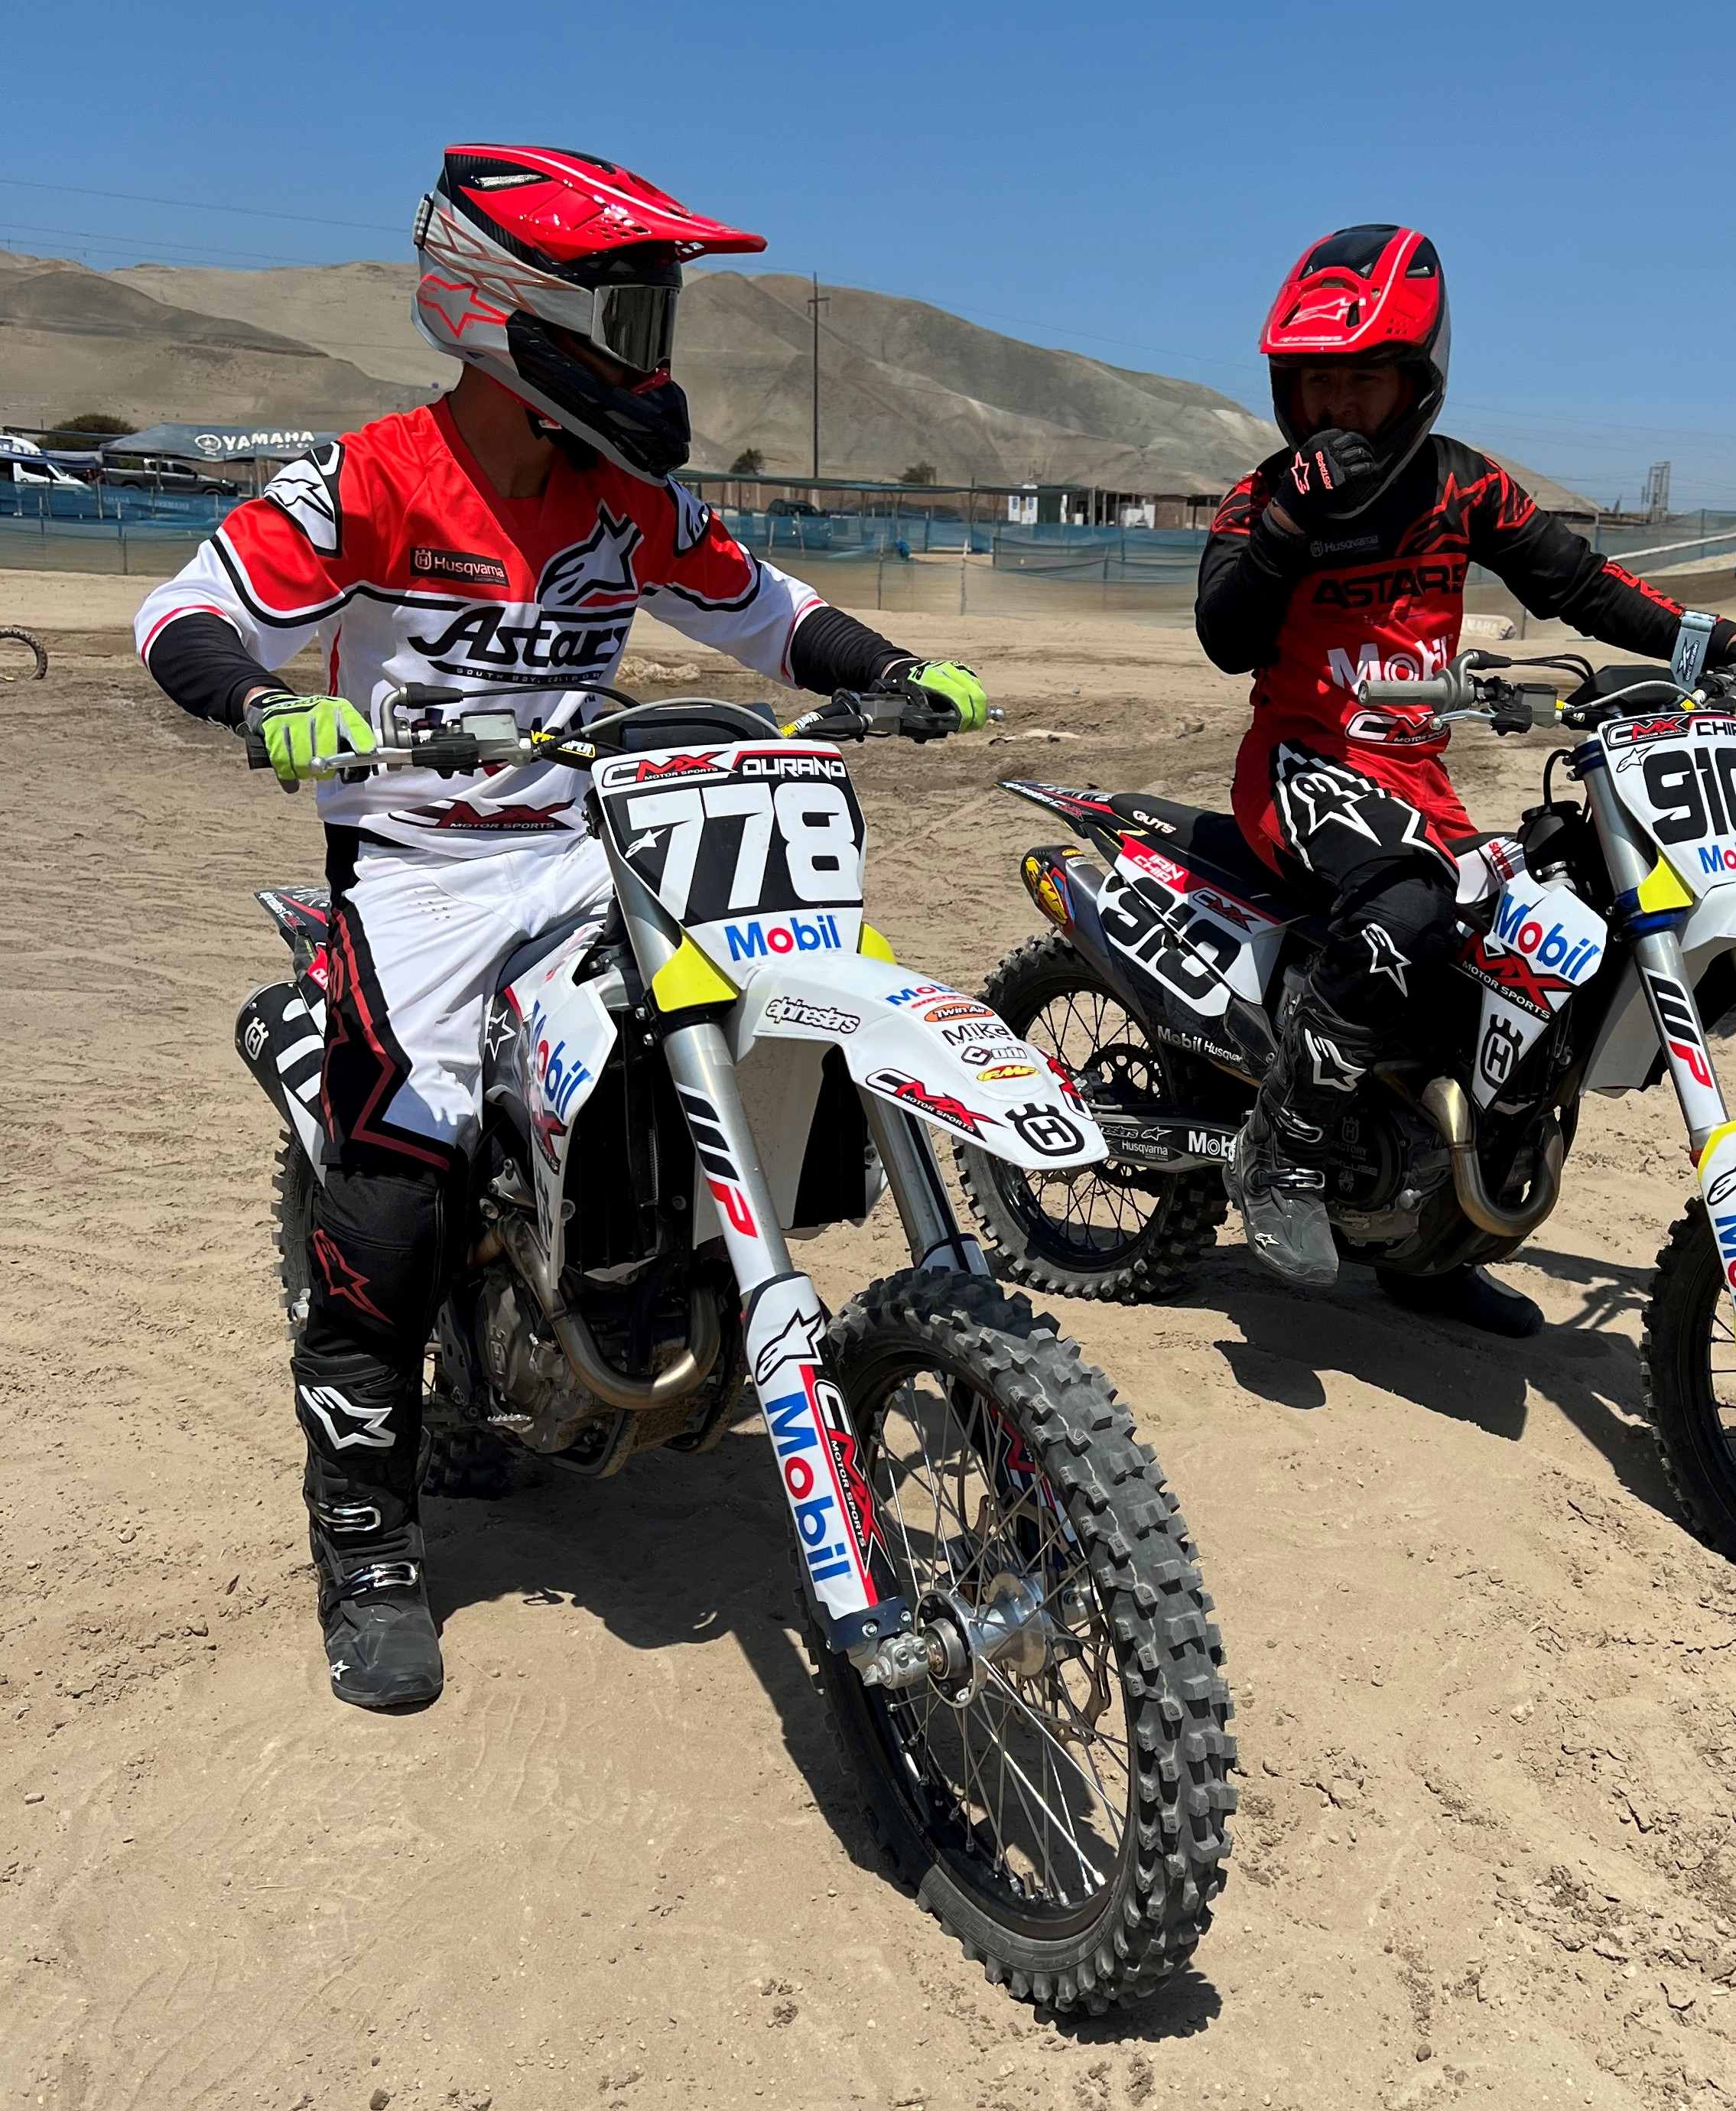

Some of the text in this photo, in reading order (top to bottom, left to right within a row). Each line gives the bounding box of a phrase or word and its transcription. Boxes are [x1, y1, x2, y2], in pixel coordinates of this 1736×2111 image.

[222, 431, 315, 451] YAMAHA
[434, 556, 505, 577] Husqvarna
[1608, 714, 1691, 746] CMX
[601, 751, 738, 789] CMX
[644, 766, 719, 781] MOTOR SPORTS
[450, 820, 556, 830] MOTOR SPORTS
[626, 782, 863, 921] 778
[724, 915, 843, 962] Mobil
[1494, 893, 1601, 981] Mobil
[1461, 960, 1551, 1020] MOTOR SPORTS
[766, 997, 861, 1034] alpinestars
[935, 1007, 968, 1019] Twin
[1157, 1025, 1203, 1053] Mobil
[866, 1068, 1009, 1143] CMX
[901, 1093, 976, 1133] MOTOR SPORTS
[1121, 1139, 1169, 1156] Husqvarna
[766, 1391, 851, 1583] Mobil
[813, 1378, 896, 1579] CMX
[831, 1439, 867, 1548] MOTOR SPORTS
